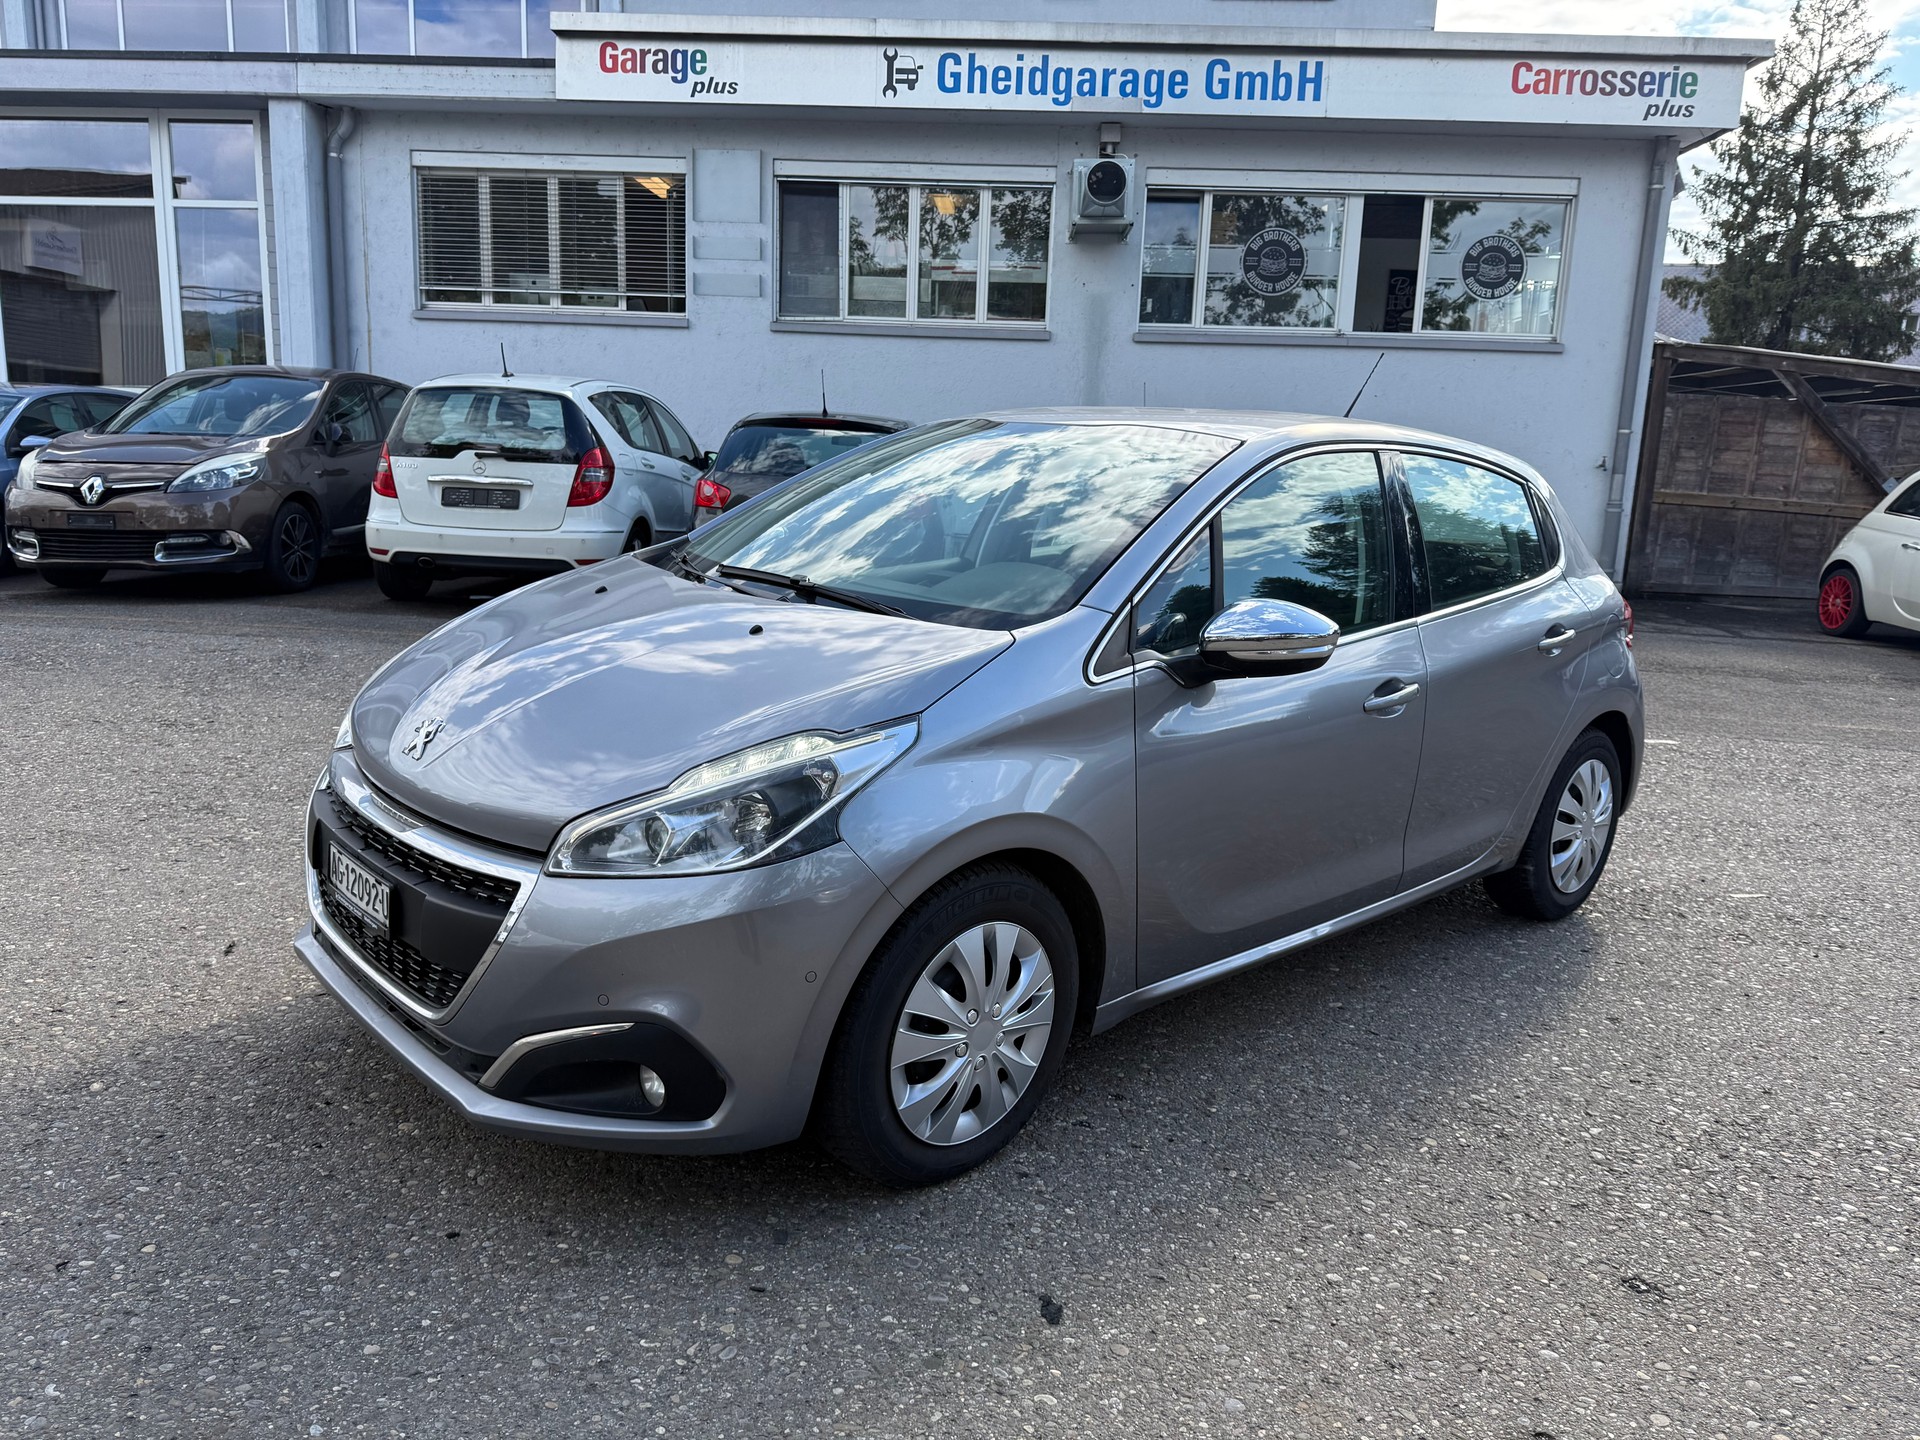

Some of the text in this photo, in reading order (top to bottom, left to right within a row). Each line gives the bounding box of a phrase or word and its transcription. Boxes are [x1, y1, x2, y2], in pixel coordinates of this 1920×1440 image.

[599, 41, 707, 84] Garage
[690, 76, 739, 98] plus
[936, 52, 1324, 108] Gheidgarage GmbH
[1511, 61, 1699, 99] Carrosserie
[1642, 99, 1696, 121] plus
[1249, 230, 1301, 252] BIG BROTHERS
[1468, 236, 1520, 258] BIG BROTHERS
[1246, 270, 1299, 292] BURGER HOUSE
[1465, 276, 1519, 298] BURGER HOUSE
